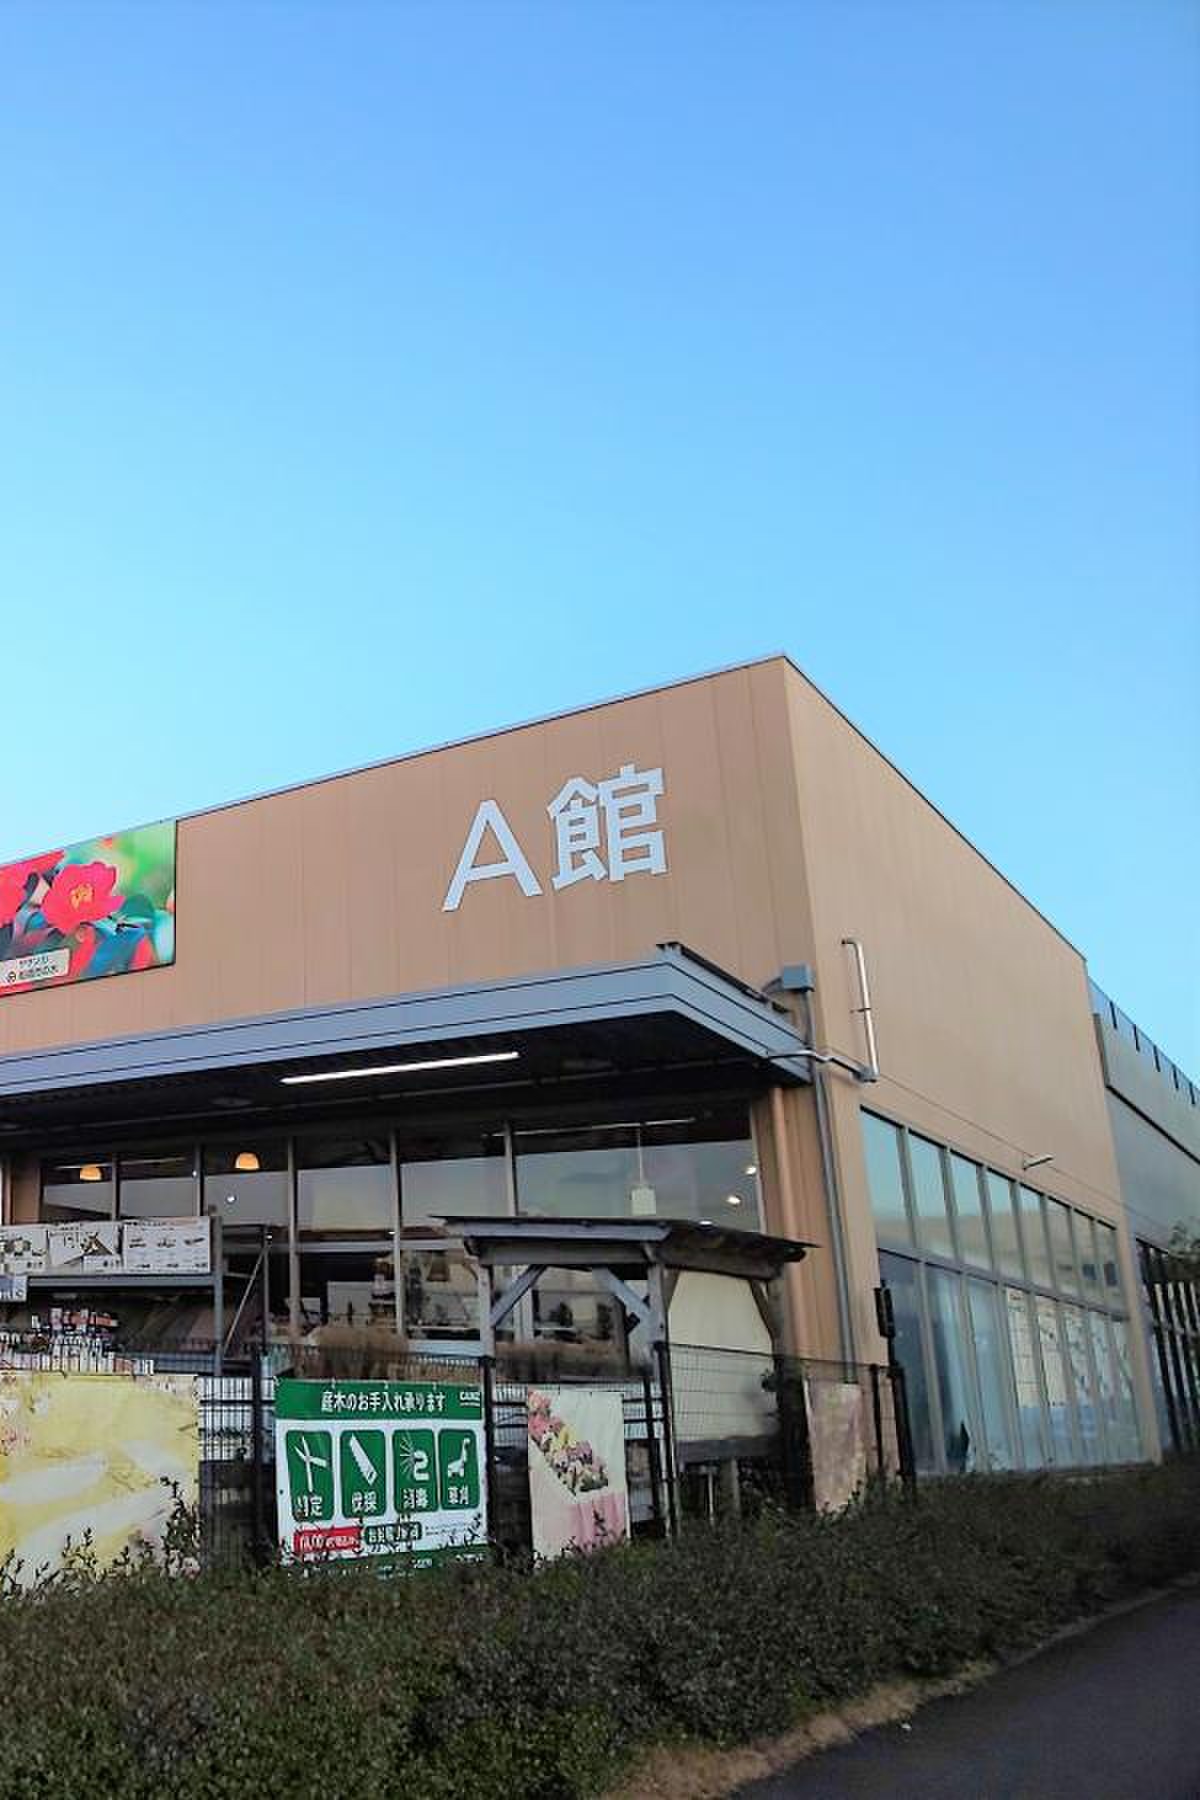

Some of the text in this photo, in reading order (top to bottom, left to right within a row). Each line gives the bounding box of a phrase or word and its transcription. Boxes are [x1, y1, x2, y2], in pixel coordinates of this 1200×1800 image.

[441, 763, 668, 912] A館
[321, 1389, 446, 1413] 庭木のお手入れ承ります
